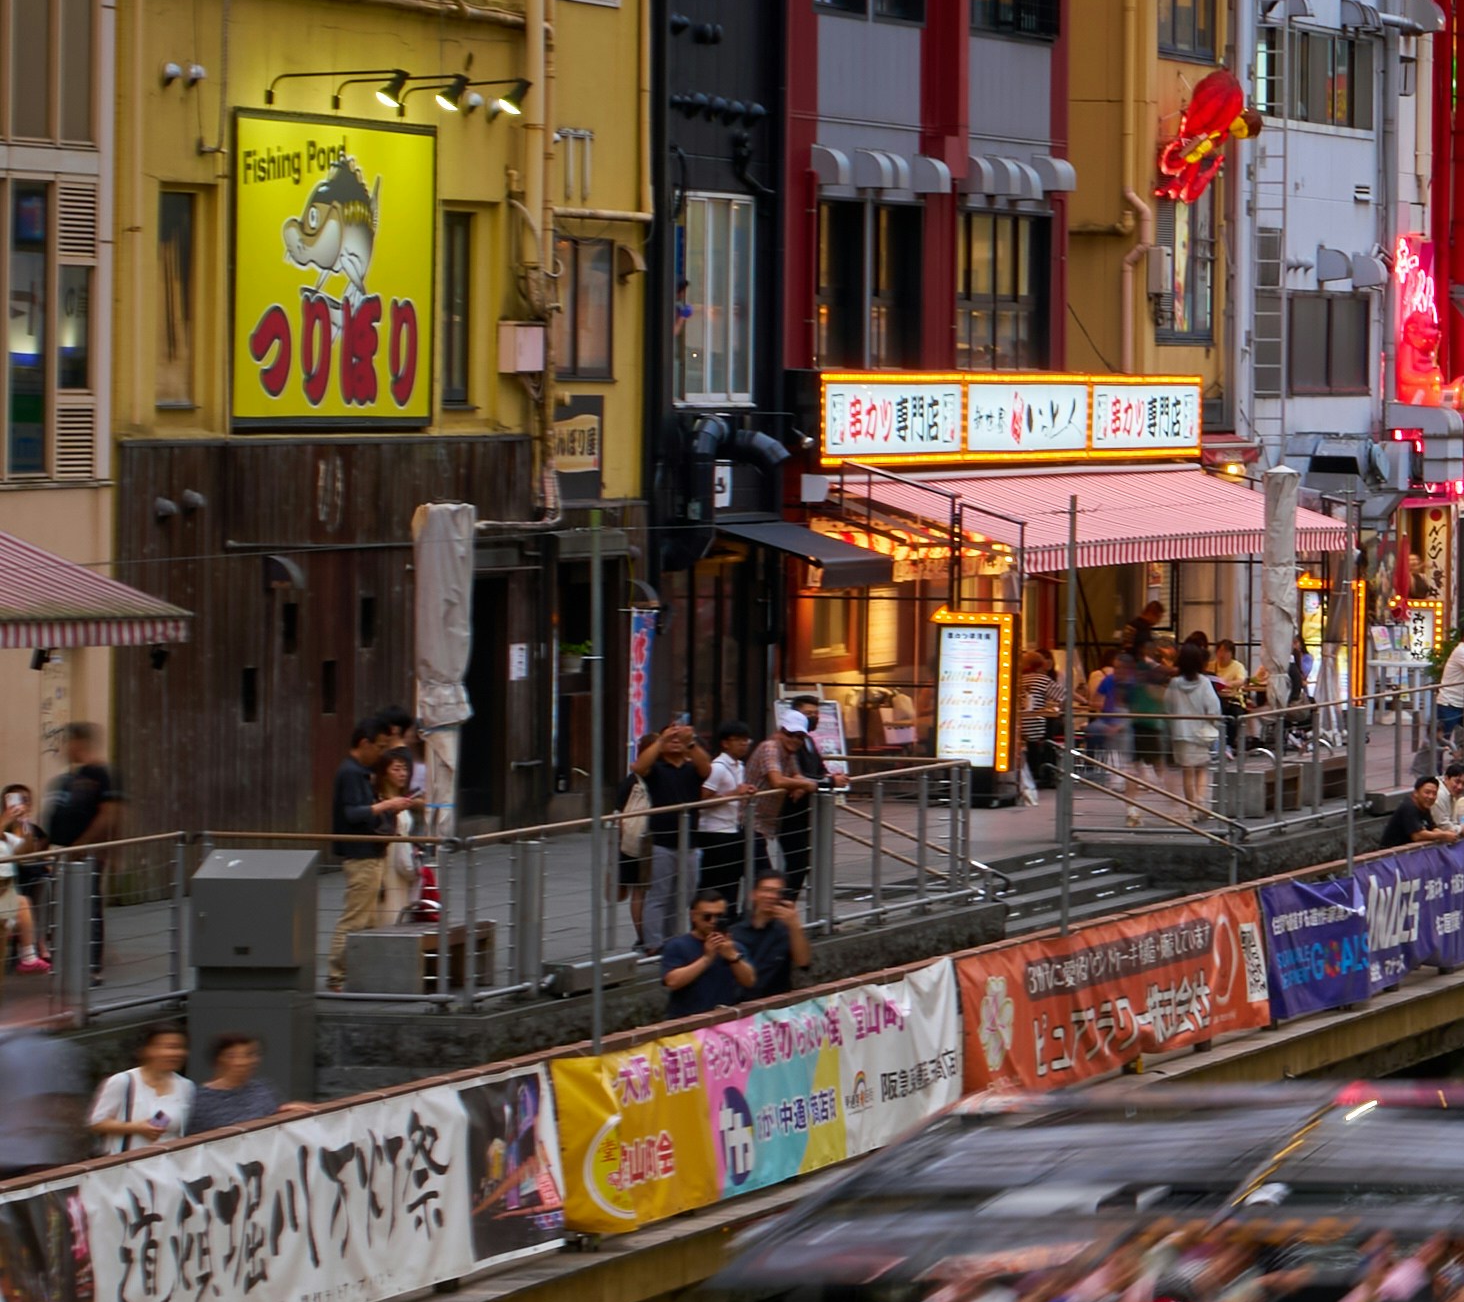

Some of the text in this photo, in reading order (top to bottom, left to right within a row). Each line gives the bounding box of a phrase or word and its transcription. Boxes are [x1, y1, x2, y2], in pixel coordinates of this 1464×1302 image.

[243, 147, 302, 186] Fishing
[249, 294, 419, 409] つりぼり
